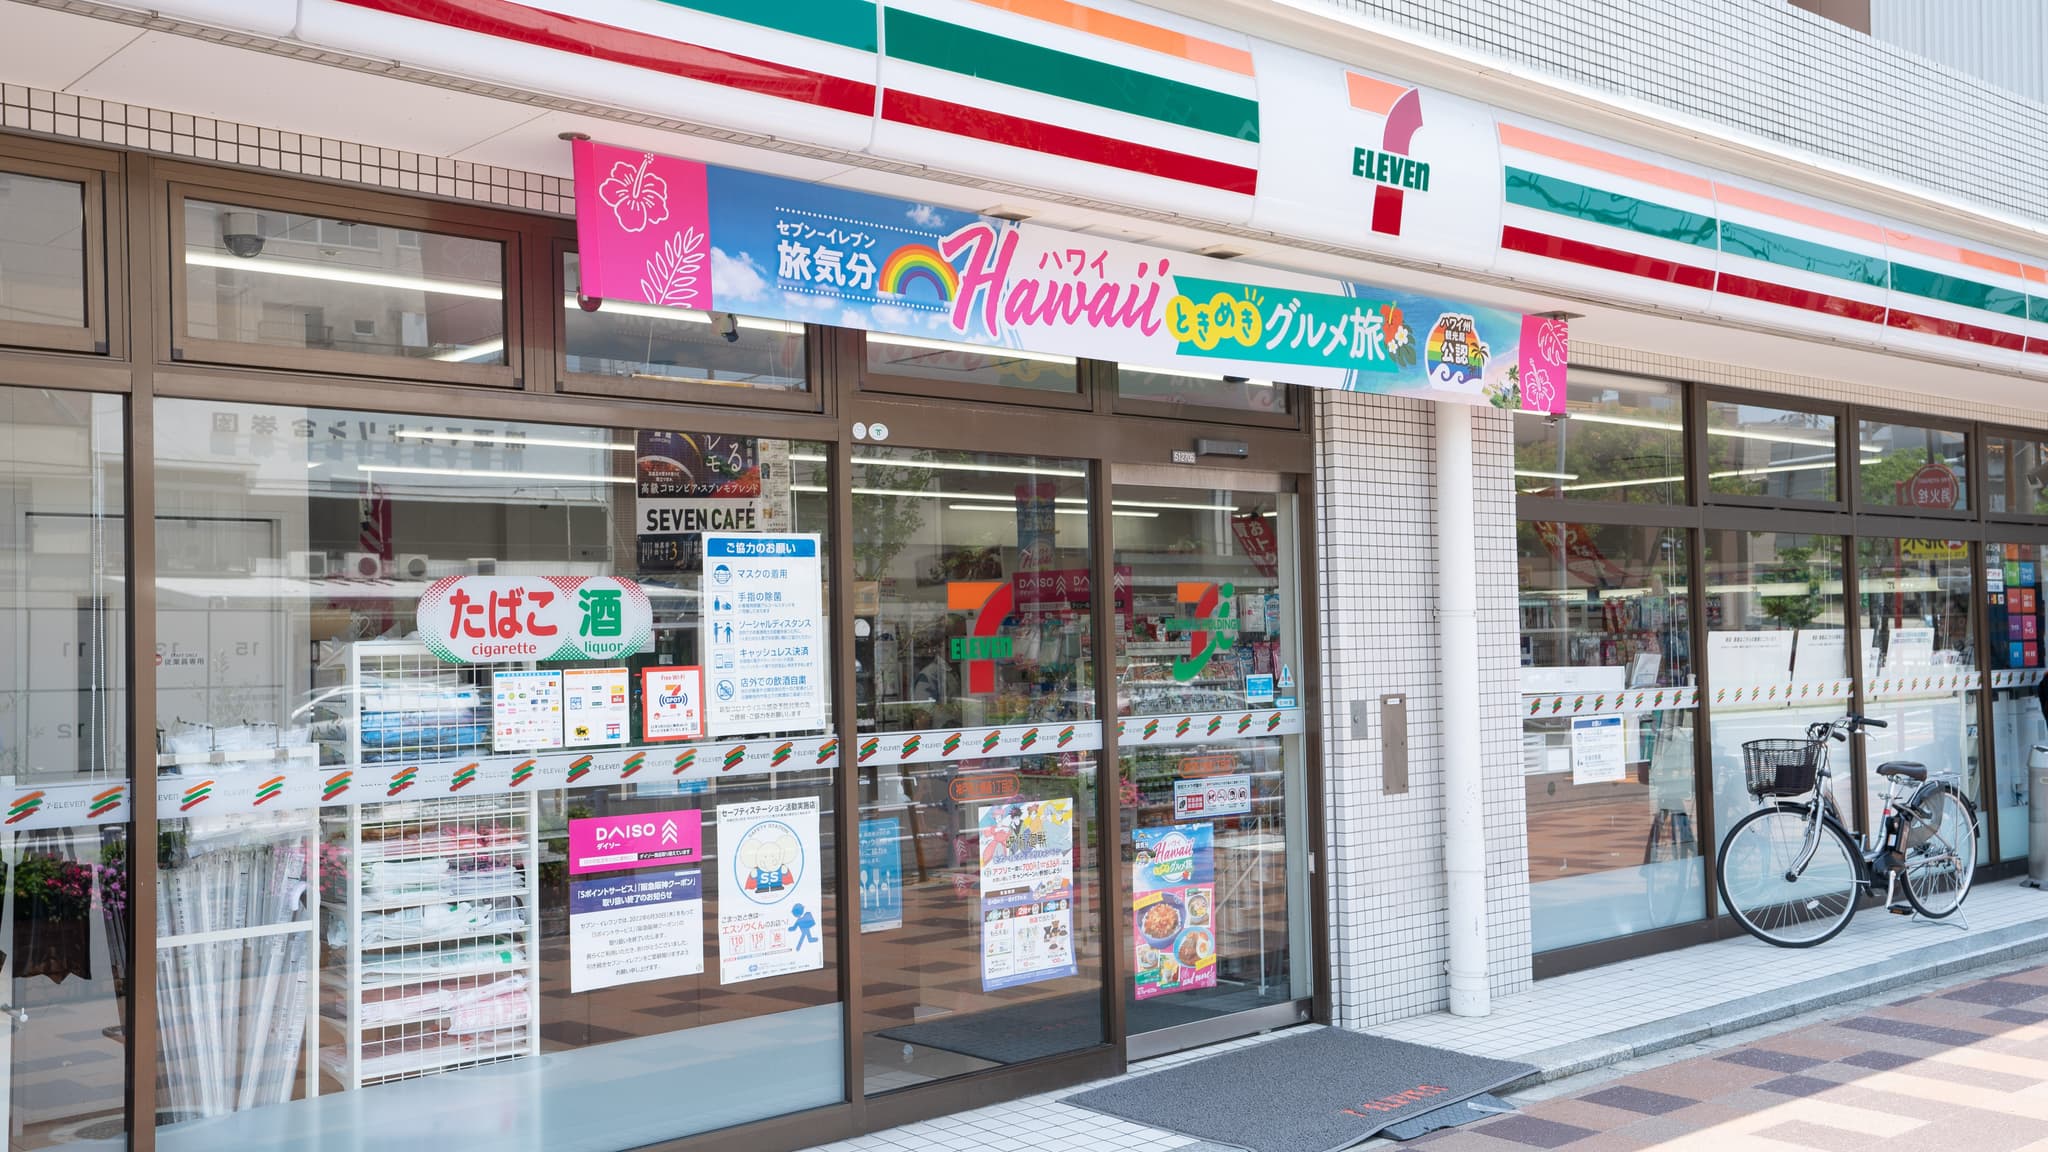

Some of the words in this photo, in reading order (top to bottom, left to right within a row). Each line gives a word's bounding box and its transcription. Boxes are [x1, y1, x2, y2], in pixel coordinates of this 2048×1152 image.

[777, 239, 878, 291] 旅気分
[1038, 249, 1109, 279] ハワイ
[941, 224, 1170, 338] Hawaii
[1440, 318, 1472, 333] ハワイ州
[1441, 341, 1469, 364] 公認
[646, 508, 708, 531] SEVEN
[726, 542, 797, 554] ご協力のお願い
[737, 569, 788, 579] マスクの着用
[1019, 577, 1054, 589] DAISO
[449, 586, 558, 640] たばこ
[578, 588, 622, 638] 酒
[739, 619, 812, 629] ソーシャルディスタンス
[471, 641, 537, 658] cigarette
[584, 640, 624, 656] liquor
[739, 646, 809, 657] キャッシュレス決済
[740, 675, 807, 688] 店外での飲酒自粛
[721, 801, 816, 818] セーフティステーション活動実施店
[596, 823, 656, 841] DAISO
[596, 842, 621, 850] ダイソー
[1152, 838, 1196, 864] Hawaii
[731, 935, 744, 945] 110
[751, 932, 764, 945] 119
